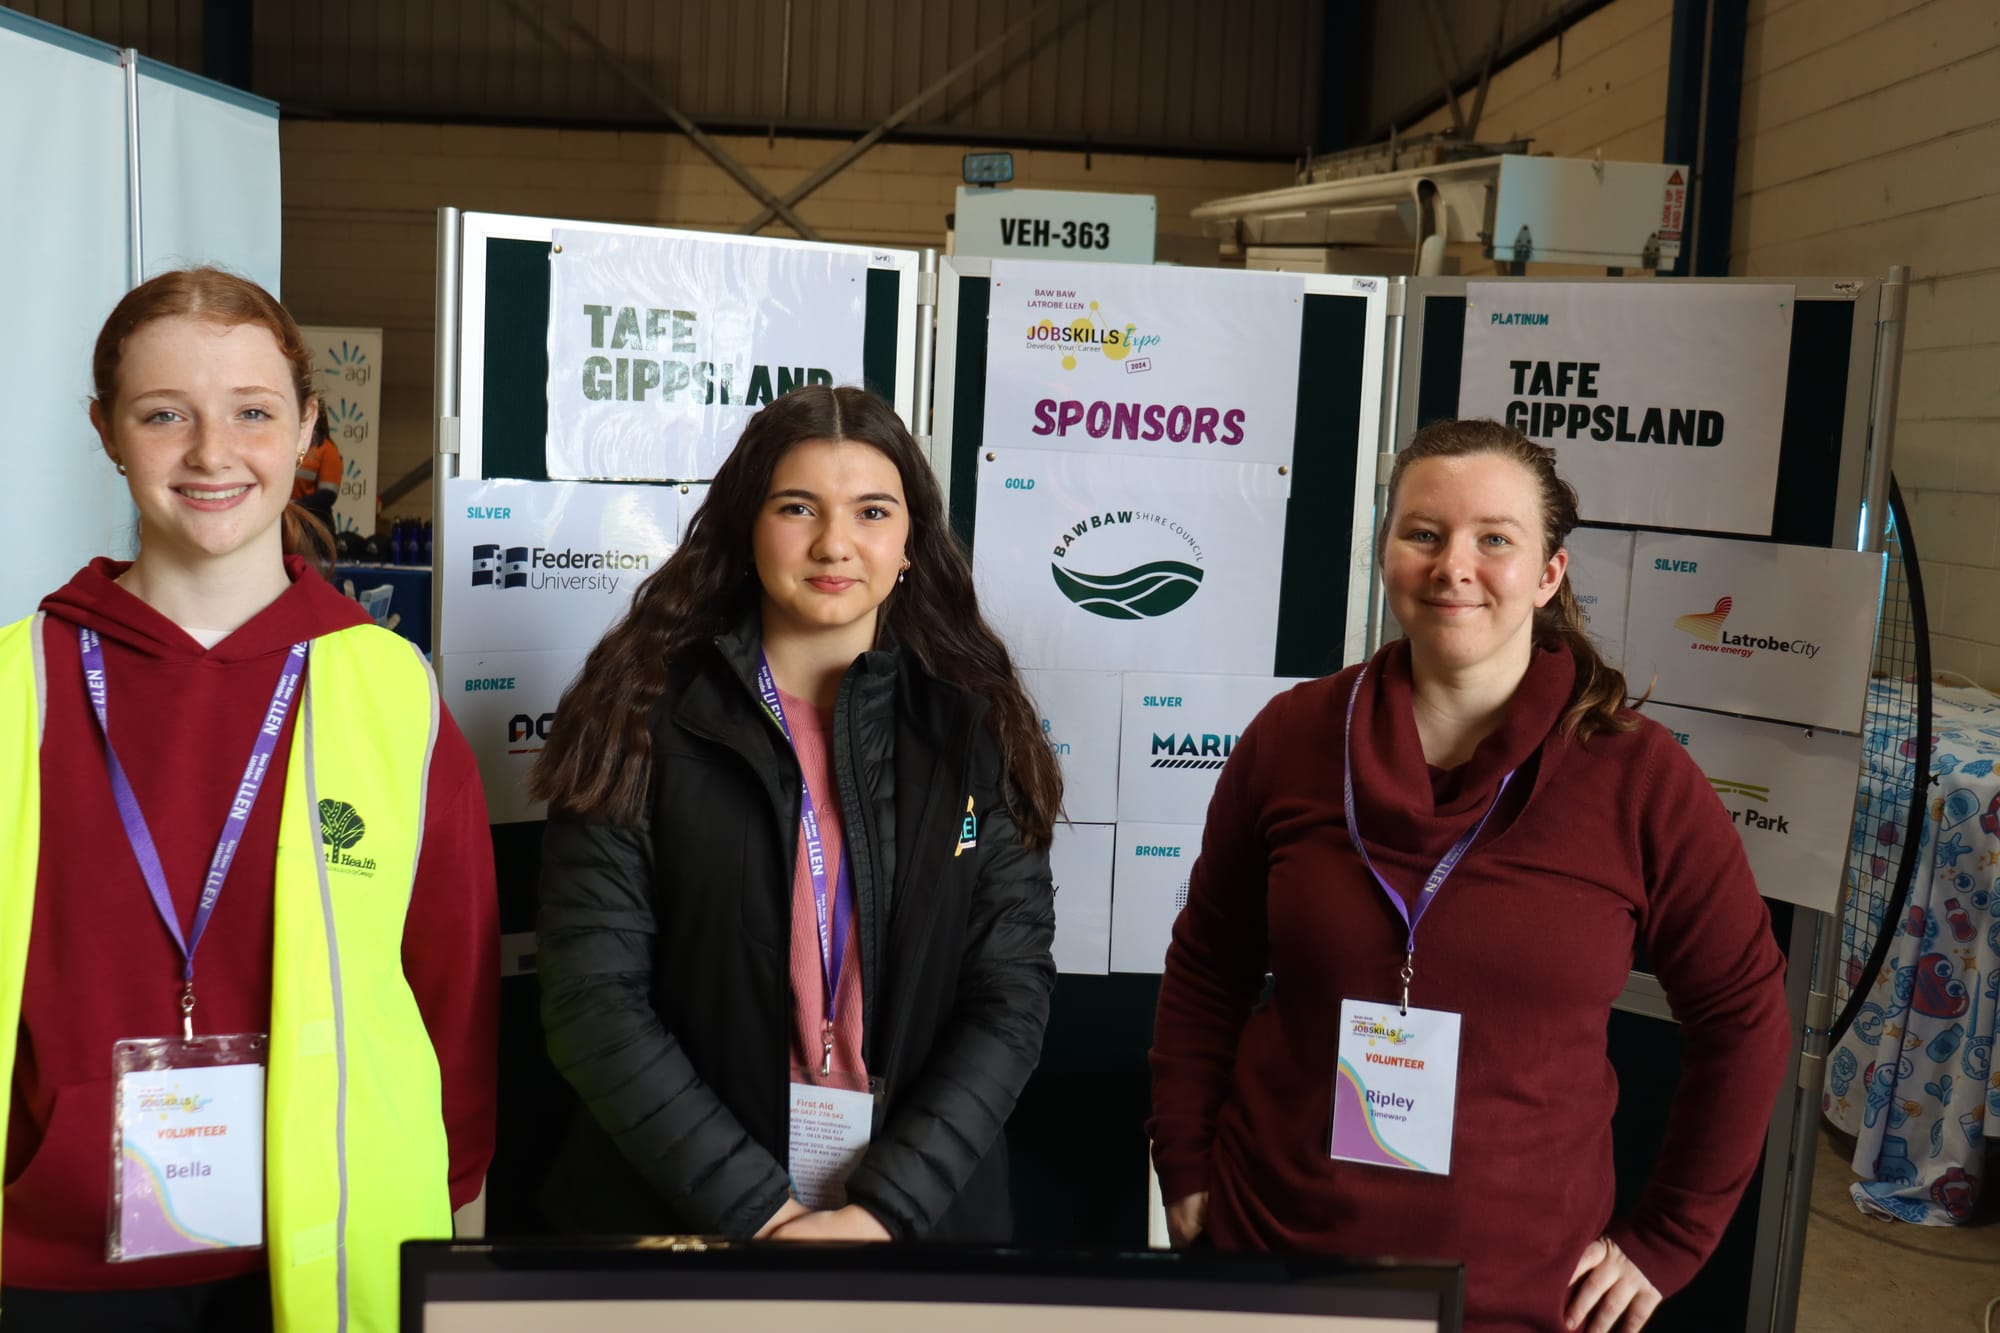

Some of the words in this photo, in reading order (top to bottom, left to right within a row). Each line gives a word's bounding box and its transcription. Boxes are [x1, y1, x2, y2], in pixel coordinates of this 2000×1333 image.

[1000, 218, 1110, 250] VEH-363
[1035, 289, 1054, 298] BAW
[1056, 290, 1076, 299] BAW
[1027, 300, 1063, 309] LATROBE
[1065, 302, 1085, 310] LLEN
[584, 303, 697, 353] TAFE
[1491, 313, 1549, 326] PLATINUM
[1026, 342, 1056, 351] Develop
[1058, 344, 1075, 352] Your
[1027, 325, 1120, 344] JOBSKILLS
[1122, 327, 1161, 353] Expo
[345, 365, 371, 386] agl
[1509, 360, 1600, 398] TAFE
[343, 422, 368, 443] agl
[1032, 398, 1246, 446] SPONSORS
[1505, 400, 1725, 447] GIPPSLAND
[341, 480, 367, 501] agl
[1005, 478, 1035, 490] GOLD
[467, 506, 511, 519] SILVER
[1053, 520, 1088, 557] BAW
[1090, 511, 1133, 529] BAW
[1135, 511, 1168, 527] SHIRE
[1169, 522, 1203, 562] COUNCIL
[532, 547, 649, 570] Federation
[1654, 558, 1698, 573] SILVER
[531, 571, 619, 594] University
[1691, 642, 1697, 650] a
[1698, 642, 1719, 652] new
[1720, 645, 1754, 658] energy
[87, 669, 106, 704] LLEN
[465, 677, 515, 691] BRONZE
[1143, 696, 1182, 707] SILVER
[264, 700, 287, 736] LLEN
[230, 782, 257, 820] LLEN
[1745, 809, 1789, 834] Park
[341, 854, 376, 870] Health
[808, 841, 824, 876] LLEN
[1135, 846, 1181, 857] BRONZE
[1425, 863, 1450, 892] LLEN
[200, 871, 223, 909] LLEN
[1366, 1053, 1425, 1070] VOLUNTEER
[796, 1098, 816, 1109] First
[819, 1102, 834, 1111] Aid
[1366, 1089, 1415, 1112] Ripley
[1370, 1109, 1408, 1122] Timewarp
[157, 1125, 227, 1139] VOLUNTEER
[166, 1161, 212, 1179] Bella
